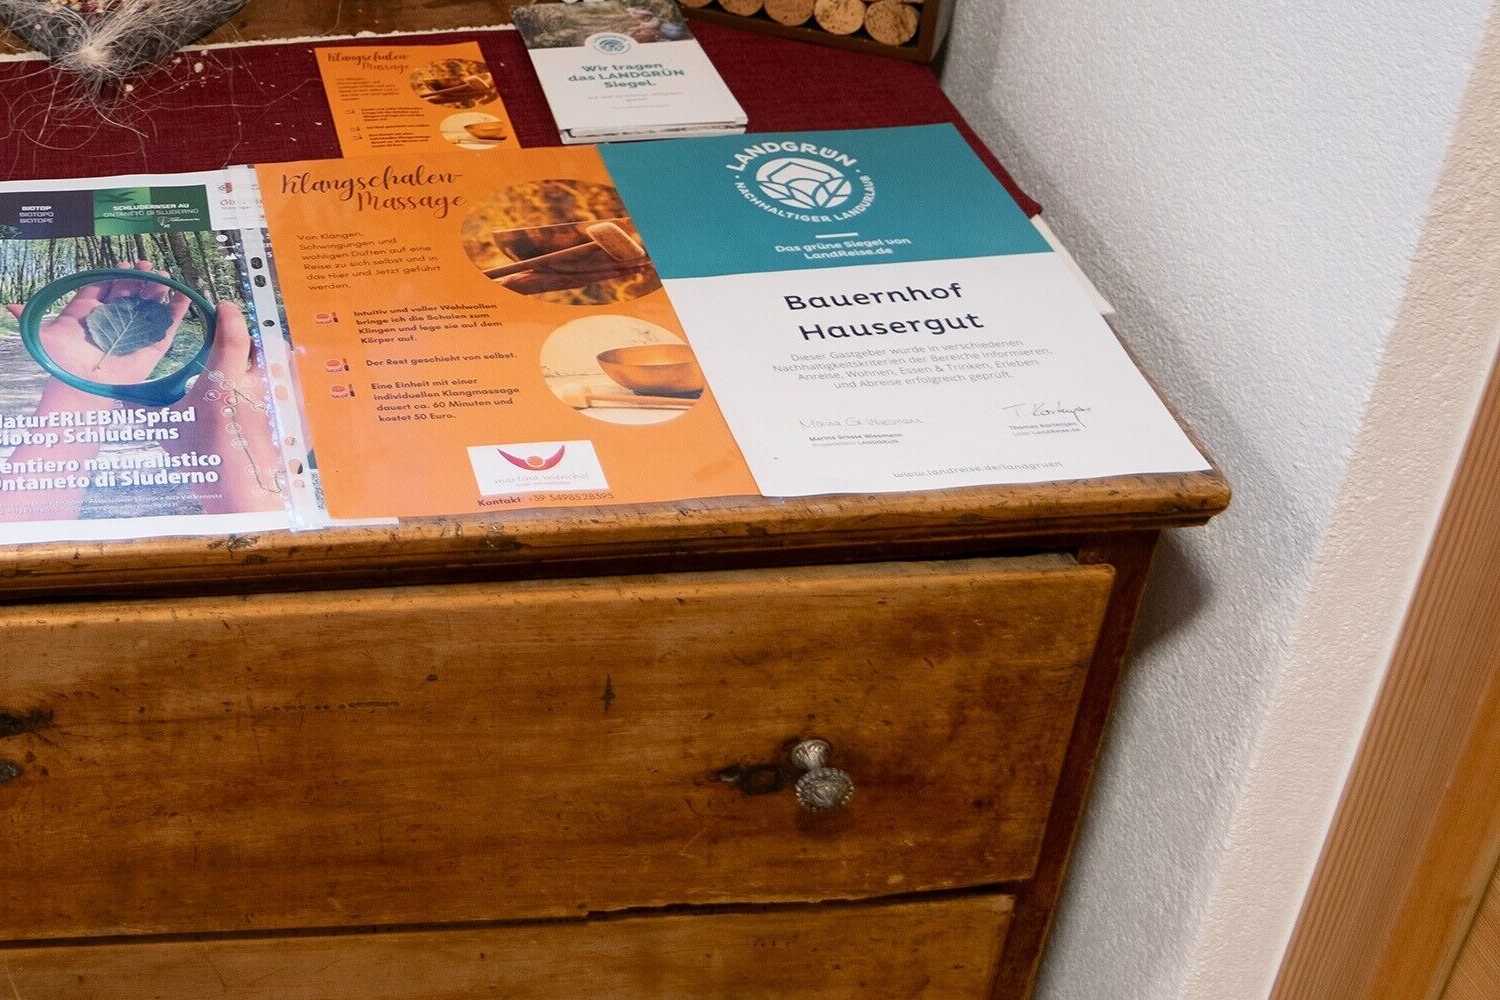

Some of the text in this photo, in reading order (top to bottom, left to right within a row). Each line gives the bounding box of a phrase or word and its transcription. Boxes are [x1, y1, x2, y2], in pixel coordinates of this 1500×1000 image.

[568, 68, 685, 82] das LANDGRÜN
[581, 63, 663, 72] Wir tragen
[357, 190, 467, 219] Massage
[734, 181, 833, 223] NACHHALTIGER
[299, 237, 397, 250] Schwingungen und
[389, 246, 407, 254] auf
[775, 237, 912, 254] Das grüne Siegel von
[373, 257, 403, 265] selbst
[406, 255, 426, 263] und
[803, 246, 894, 260] LandReise.de
[352, 269, 372, 277] und
[783, 282, 964, 311] Bauernhof
[353, 309, 388, 317] Intuitiv
[410, 305, 438, 313] voller
[439, 303, 498, 311] Wohlwollen
[356, 317, 389, 326] bringe
[427, 313, 467, 321] Schalen
[798, 312, 984, 341] Hausergut
[358, 327, 397, 336] Klingen
[419, 324, 442, 332] lege
[361, 334, 417, 345] Körper auf.
[790, 339, 1024, 362] Dieser Gastgeber wurde in verschiedenen
[366, 359, 383, 367] Der
[386, 357, 409, 365] Rest
[411, 355, 460, 365] geschieht
[483, 352, 517, 360] selbst.
[772, 357, 906, 375] Nachhaltigkeitskriterien
[908, 355, 929, 365] der
[930, 351, 980, 363] Bereiche
[798, 357, 1041, 382] Anreise, Wohnen, Essen & Trinken, Erleben
[371, 382, 393, 390] Eine
[395, 380, 430, 388] Einheit
[432, 379, 449, 387] mit
[833, 379, 857, 389] und
[859, 376, 903, 388] Abreise
[904, 372, 967, 385] erfolgreich
[373, 386, 520, 401] individuellen Klangmassage
[376, 397, 513, 412] dauert ca. 60 Minuten und
[379, 411, 456, 422] kostet 50 Euro.
[64, 425, 180, 444] Schluderns
[84, 452, 223, 472] naturalistico
[94, 471, 116, 488] di
[120, 470, 219, 487] Sluderno
